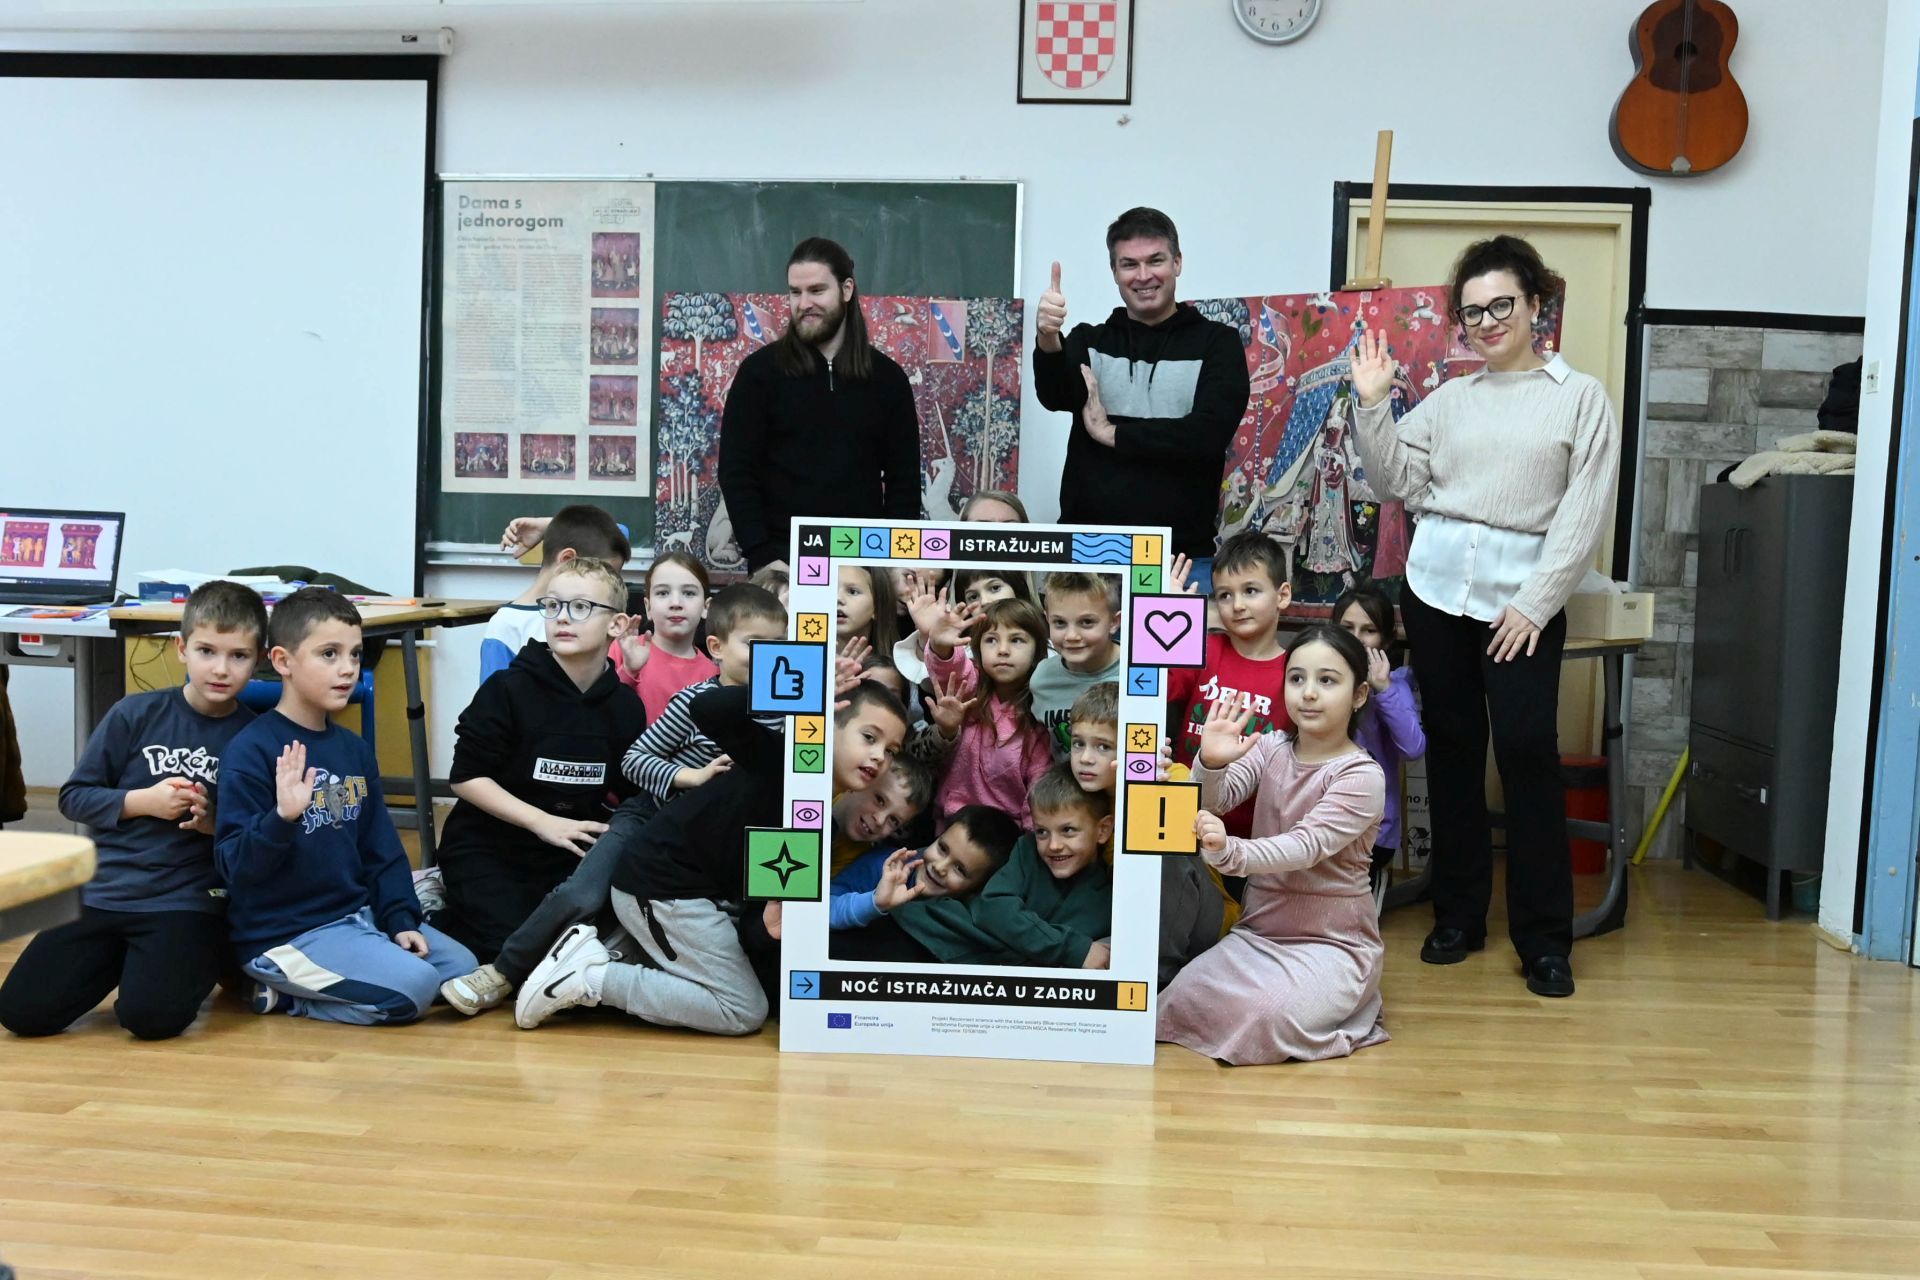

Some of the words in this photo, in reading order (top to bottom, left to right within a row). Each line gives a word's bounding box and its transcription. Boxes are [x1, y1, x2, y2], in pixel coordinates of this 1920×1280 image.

[458, 195, 510, 208] Dama
[514, 199, 522, 208] s
[458, 212, 564, 232] jednorogom
[804, 534, 824, 546] JA
[960, 538, 1064, 554] ISTRAŽUJEM
[841, 978, 879, 993] NOĆ
[887, 980, 1007, 997] ISTRAŽIVAČA
[1015, 986, 1026, 998] U
[1034, 986, 1096, 1001] ZADRU
